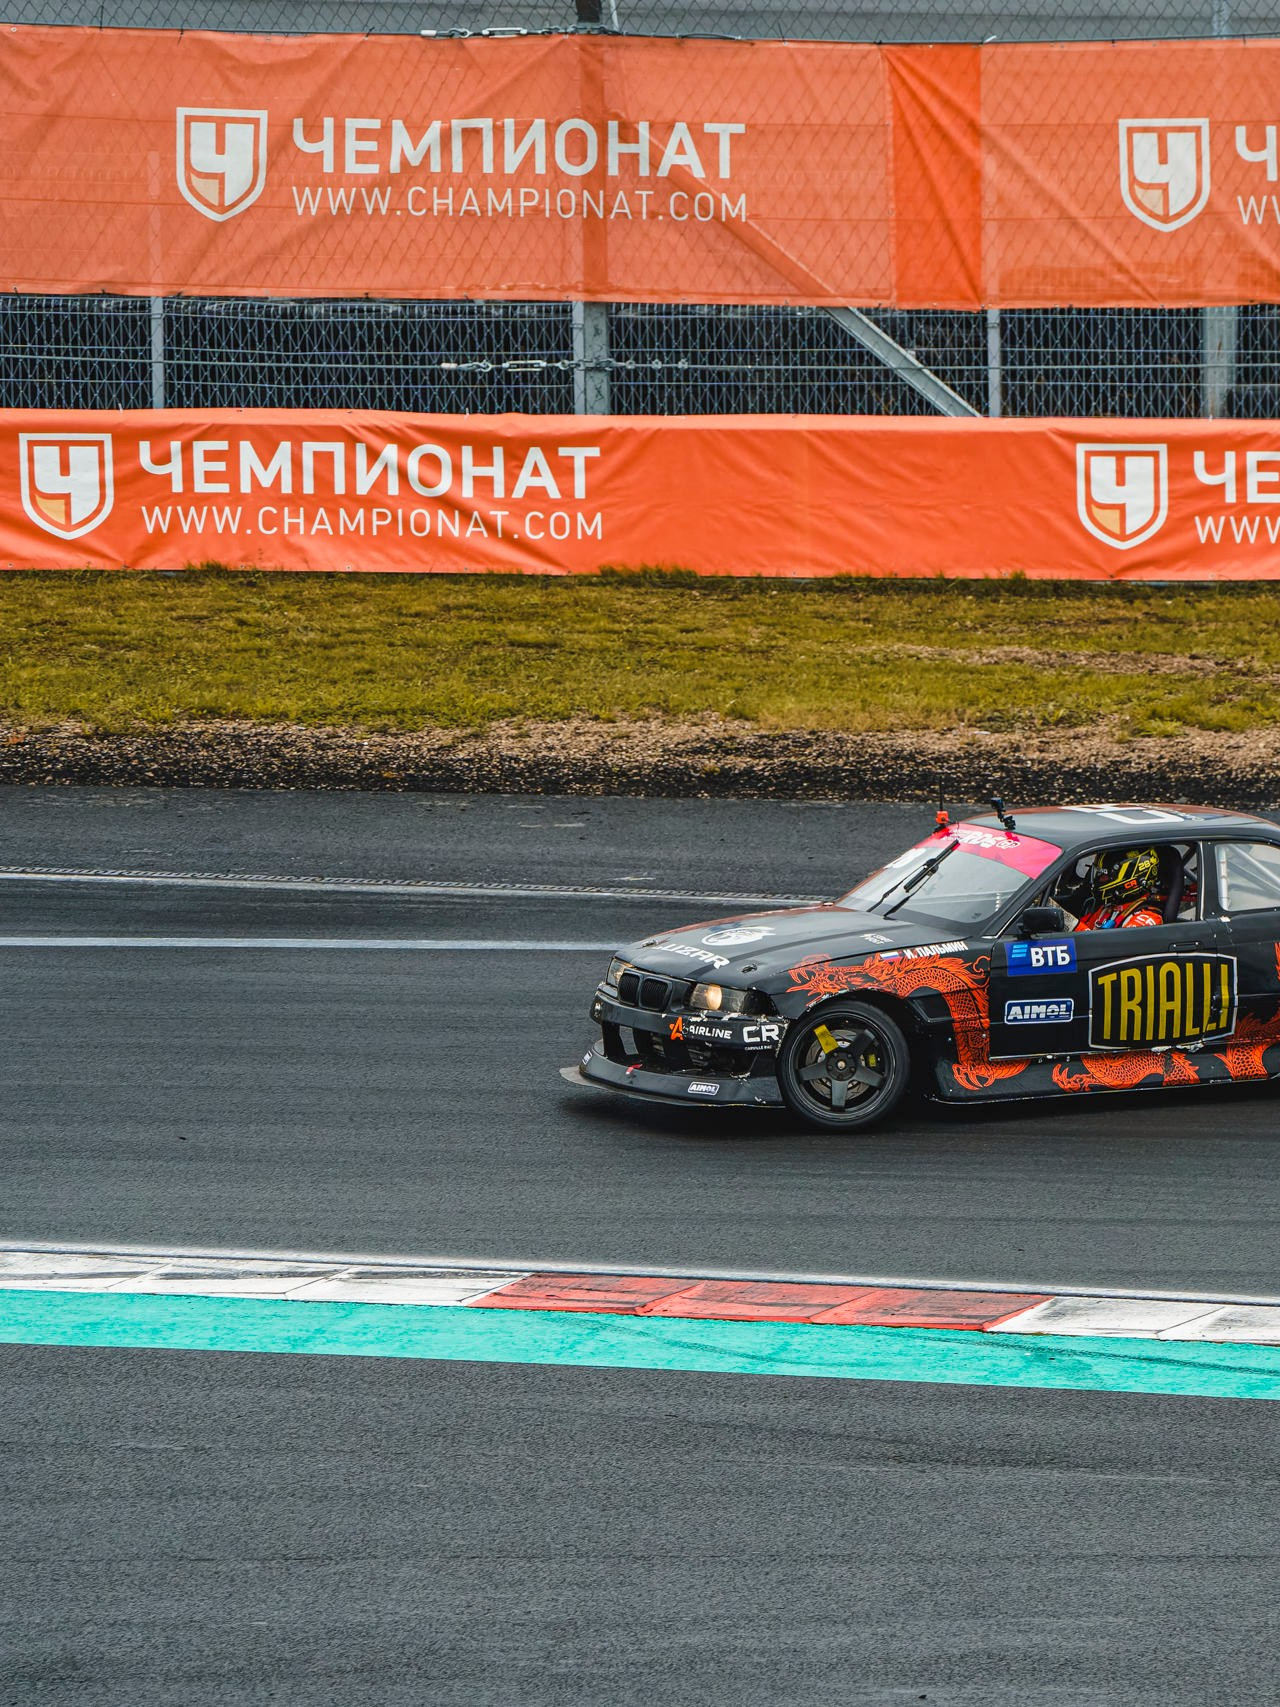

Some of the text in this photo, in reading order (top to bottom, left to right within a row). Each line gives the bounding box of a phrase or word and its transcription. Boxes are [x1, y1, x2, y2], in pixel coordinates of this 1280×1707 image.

[292, 116, 746, 177] ЧЕМПИОНАТ
[292, 186, 747, 222] WWW.CHAMPIONAT.COM
[139, 440, 600, 500] ЧЕМПИОНАТ
[141, 506, 603, 541] WWW.CHAMPIONAT.COM
[1030, 946, 1071, 967] ВТБ
[1007, 1004, 1070, 1020] AIMOL
[1097, 962, 1229, 1041] TRIALLI
[742, 1024, 780, 1043] CR
